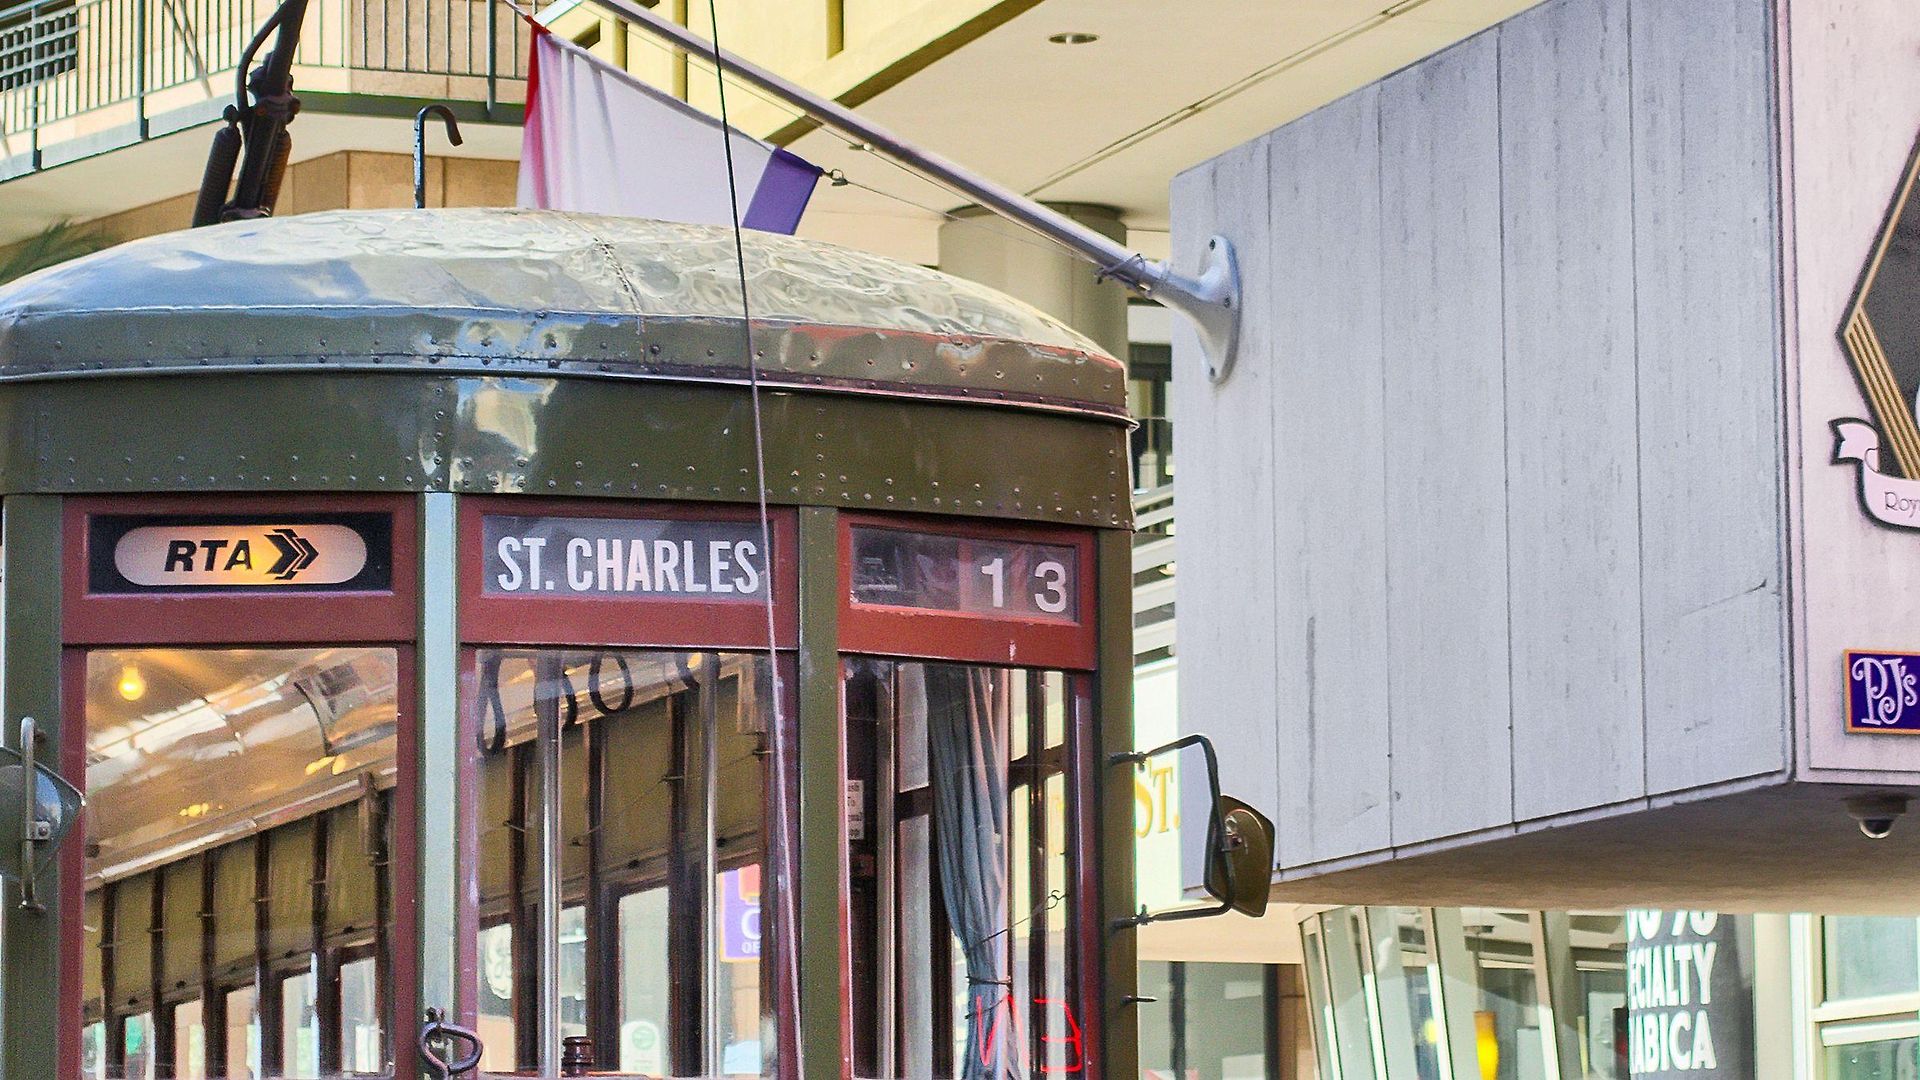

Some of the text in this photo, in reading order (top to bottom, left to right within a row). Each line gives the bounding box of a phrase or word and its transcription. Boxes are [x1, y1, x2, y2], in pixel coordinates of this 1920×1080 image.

[1884, 491, 1920, 518] Roy
[164, 539, 252, 572] RTA
[497, 536, 759, 594] ST. CHARLES
[1851, 657, 1918, 726] PJ's
[1628, 1010, 1717, 1074] ABICA
